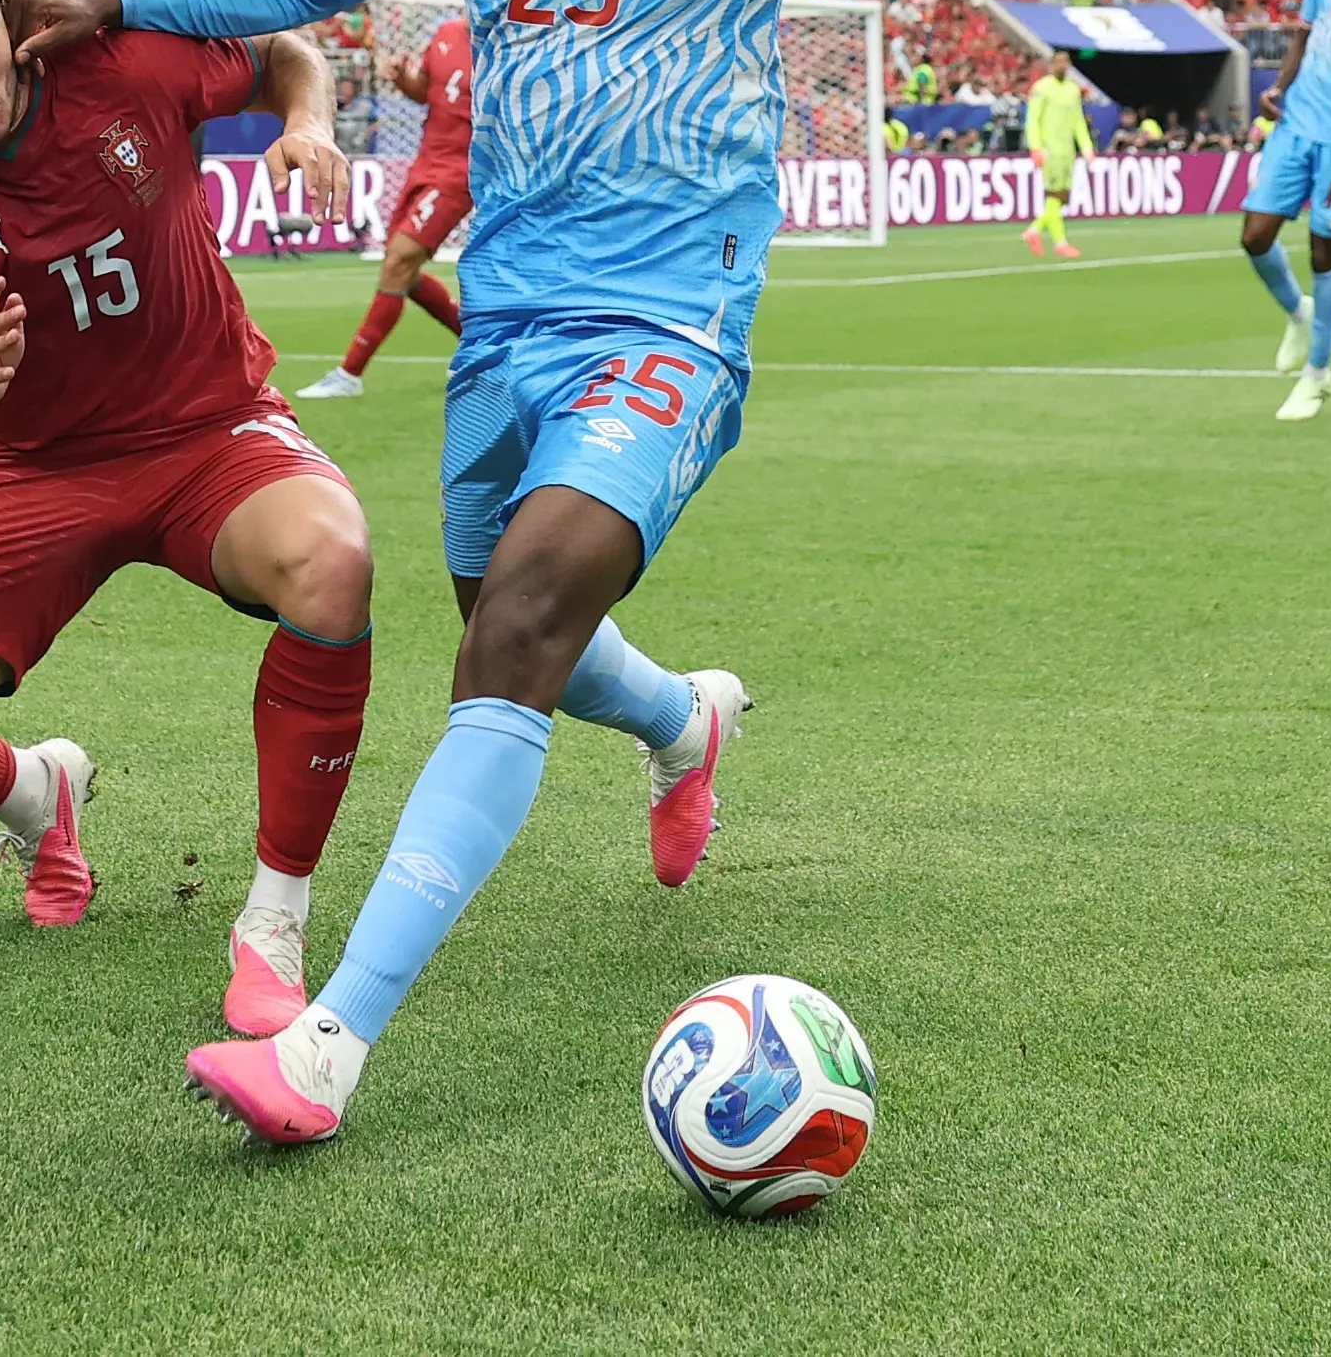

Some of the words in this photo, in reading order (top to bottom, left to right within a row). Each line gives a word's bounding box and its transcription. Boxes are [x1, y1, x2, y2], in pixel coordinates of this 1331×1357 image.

[887, 157, 936, 225] 60
[943, 154, 1183, 223] DESTIATIONS
[48, 228, 140, 331] 15
[569, 353, 696, 427] 25
[582, 434, 623, 453] umbro
